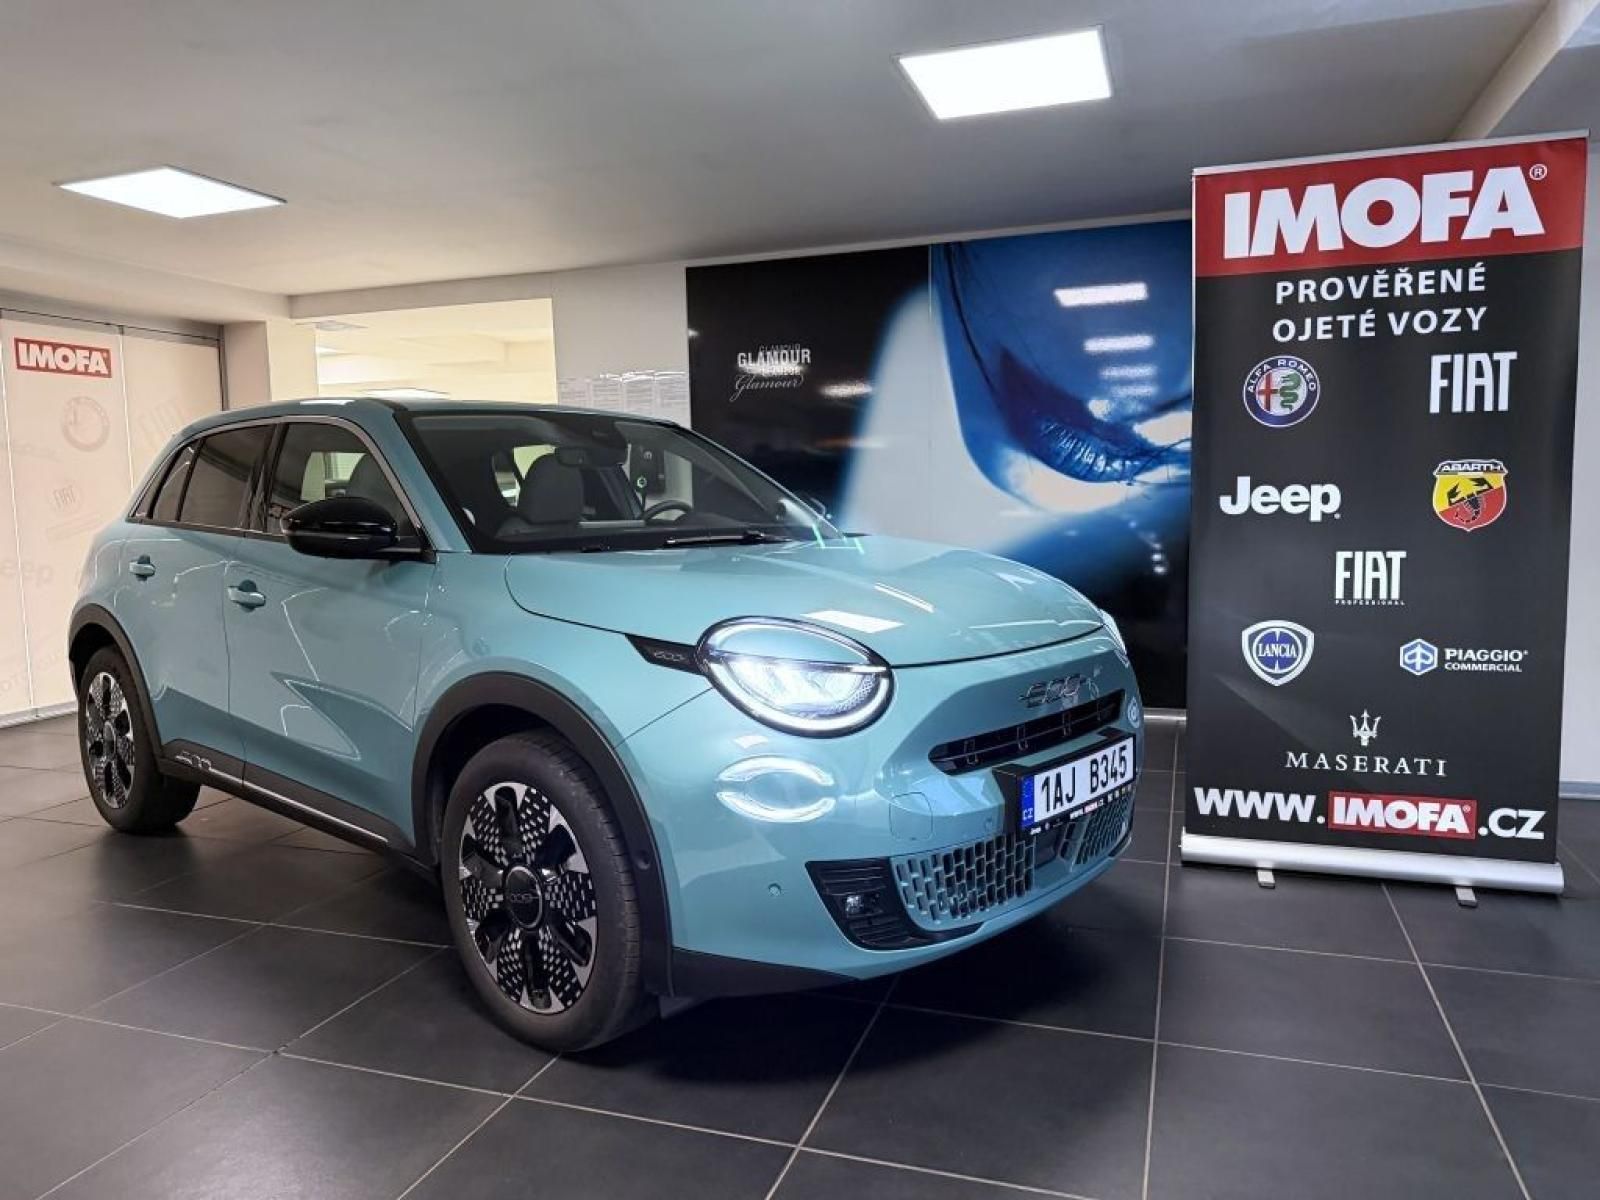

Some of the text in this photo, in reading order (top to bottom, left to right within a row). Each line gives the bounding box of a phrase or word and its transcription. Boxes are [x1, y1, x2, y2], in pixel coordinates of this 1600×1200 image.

[1276, 262, 1487, 304] PROVĚŘENÉ
[1273, 306, 1487, 342] OJETÉ VOZY
[18, 342, 109, 375] IMOFA
[737, 348, 812, 368] GLAMOUR
[1247, 359, 1317, 393] ALFA ROMEO
[1429, 351, 1518, 414] FIAT
[1441, 463, 1504, 472] ABARTH
[1219, 476, 1342, 522] Jeep
[1335, 551, 1407, 600] FIAT
[1257, 643, 1298, 658] LANCIA
[1444, 648, 1523, 662] PIAGGIO
[1444, 661, 1523, 673] COMMERCIAL
[1041, 744, 1127, 813] 1AJ B345
[1284, 751, 1447, 777] MASERATI
